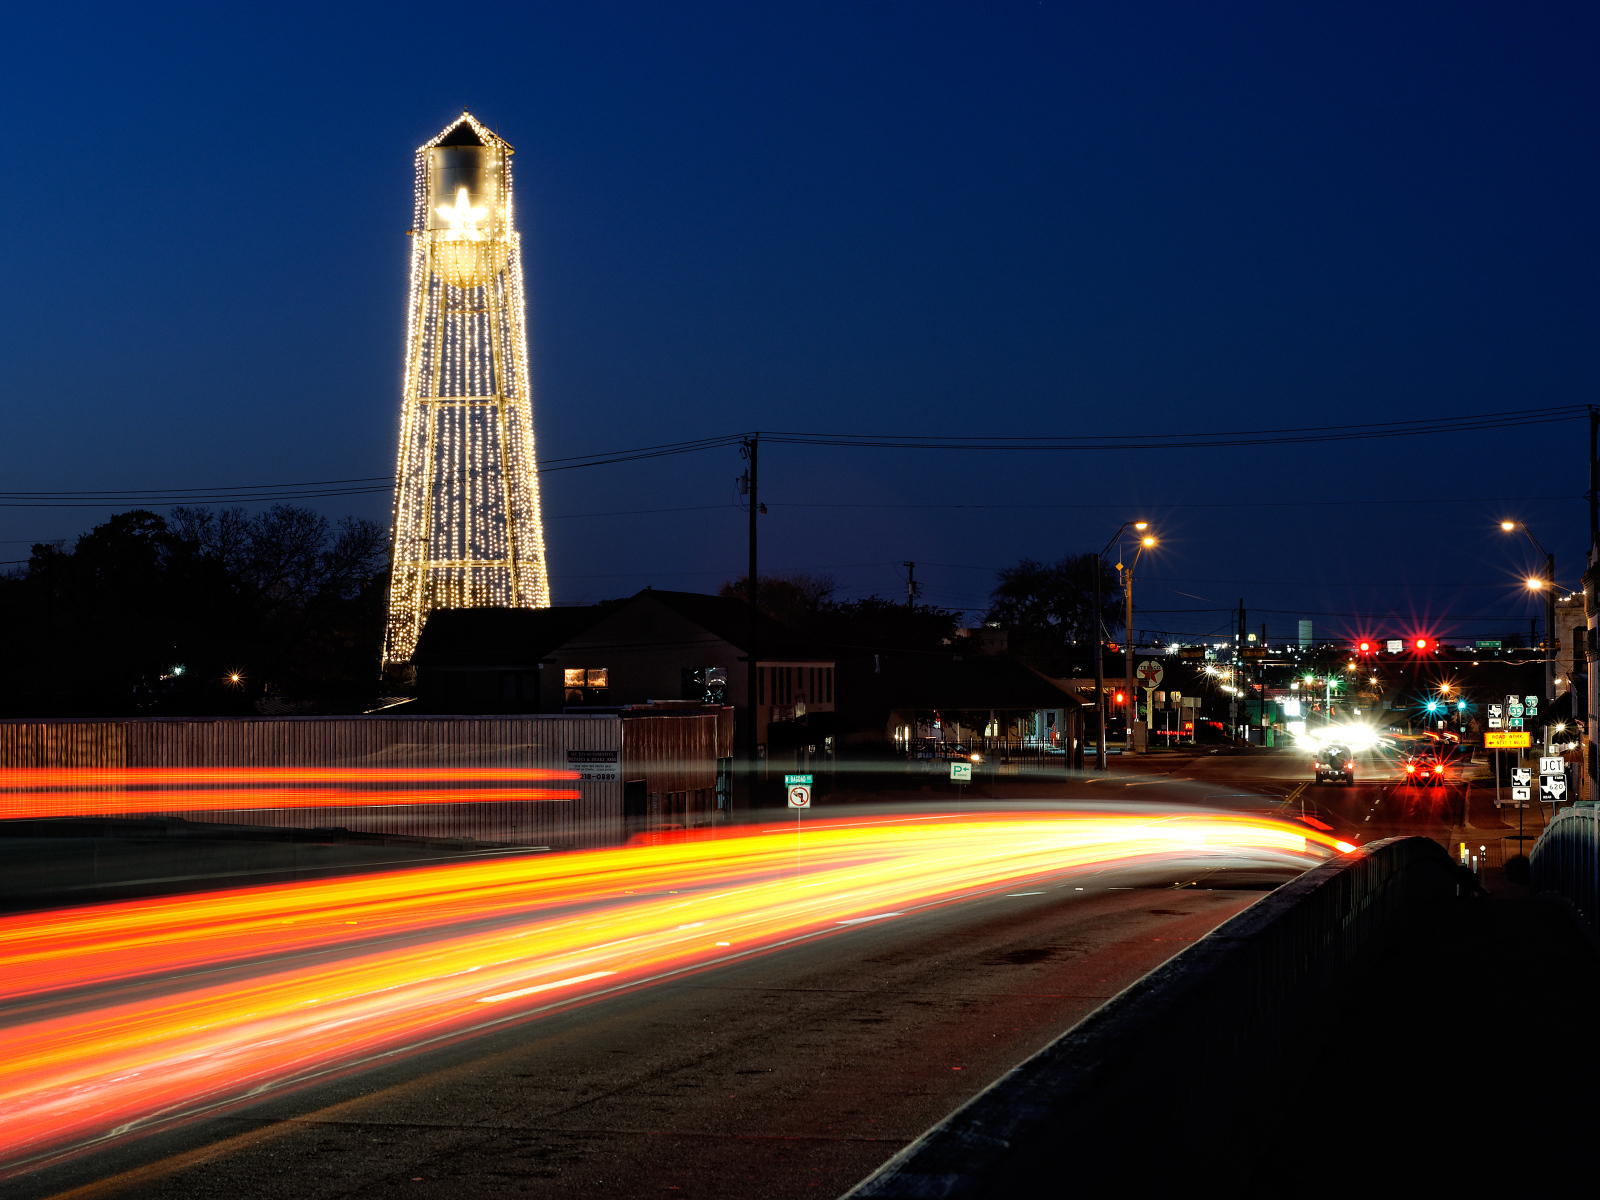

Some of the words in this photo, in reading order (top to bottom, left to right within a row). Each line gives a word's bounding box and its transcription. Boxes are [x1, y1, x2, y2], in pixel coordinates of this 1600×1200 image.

[1543, 760, 1562, 771] JCT
[954, 766, 962, 776] P
[790, 775, 806, 783] BAGDAD
